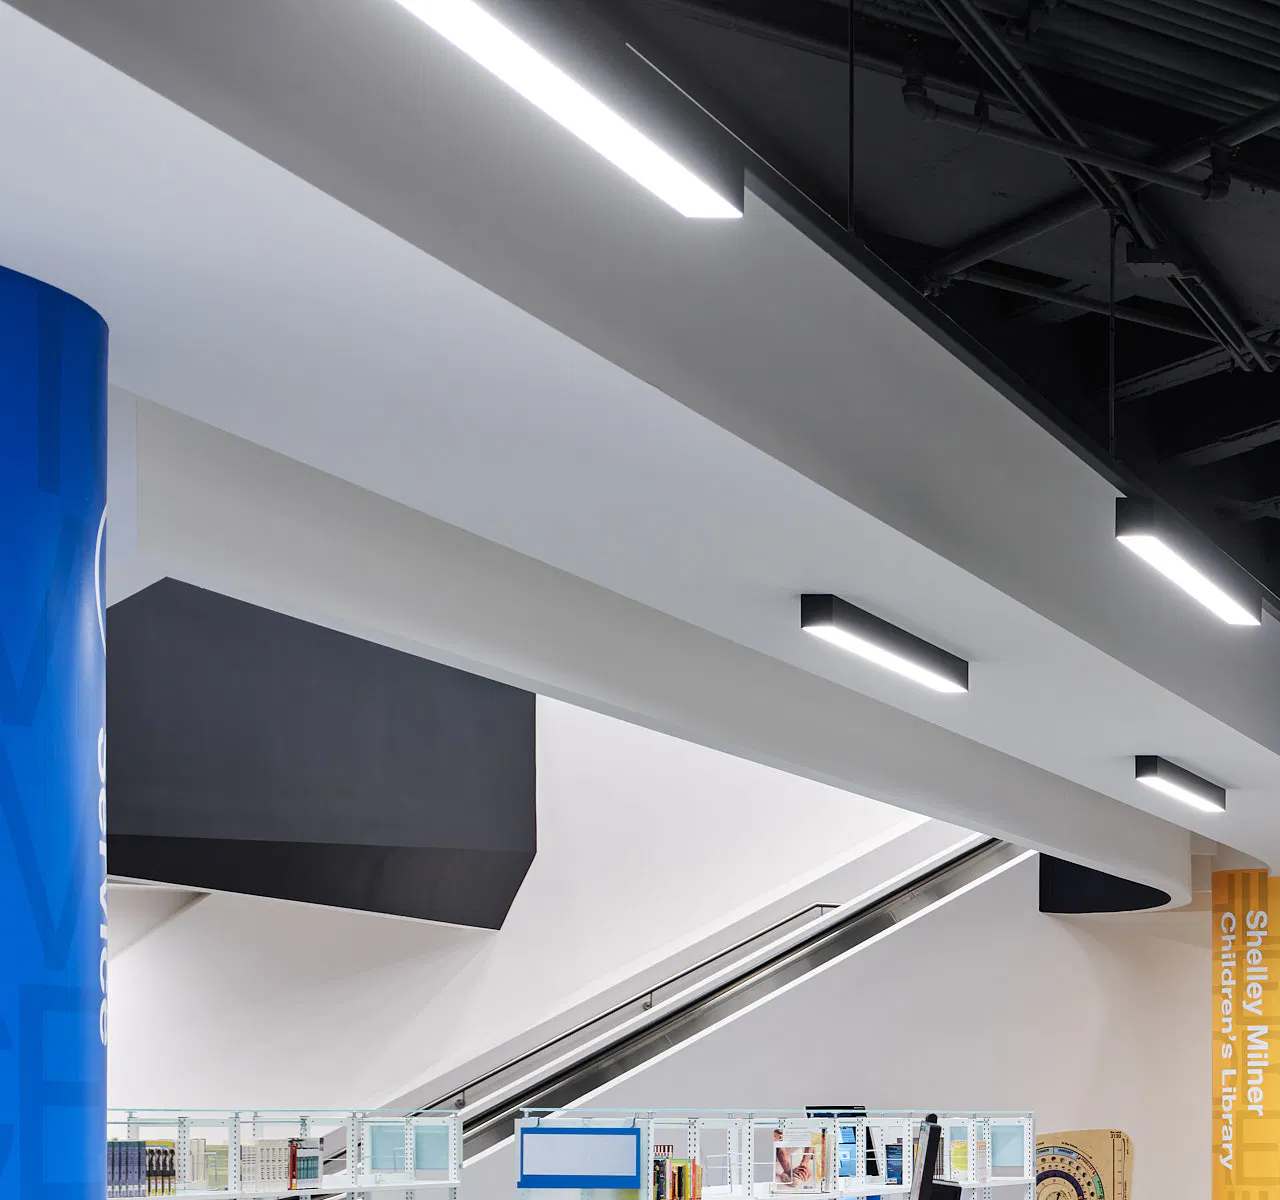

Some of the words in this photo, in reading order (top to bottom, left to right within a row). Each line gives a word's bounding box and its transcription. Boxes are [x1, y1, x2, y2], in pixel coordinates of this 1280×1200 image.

[1221, 912, 1236, 1058] Children's
[1242, 910, 1268, 1016] Shelley
[1219, 1069, 1236, 1170] Library
[1247, 1025, 1268, 1116] Milner
